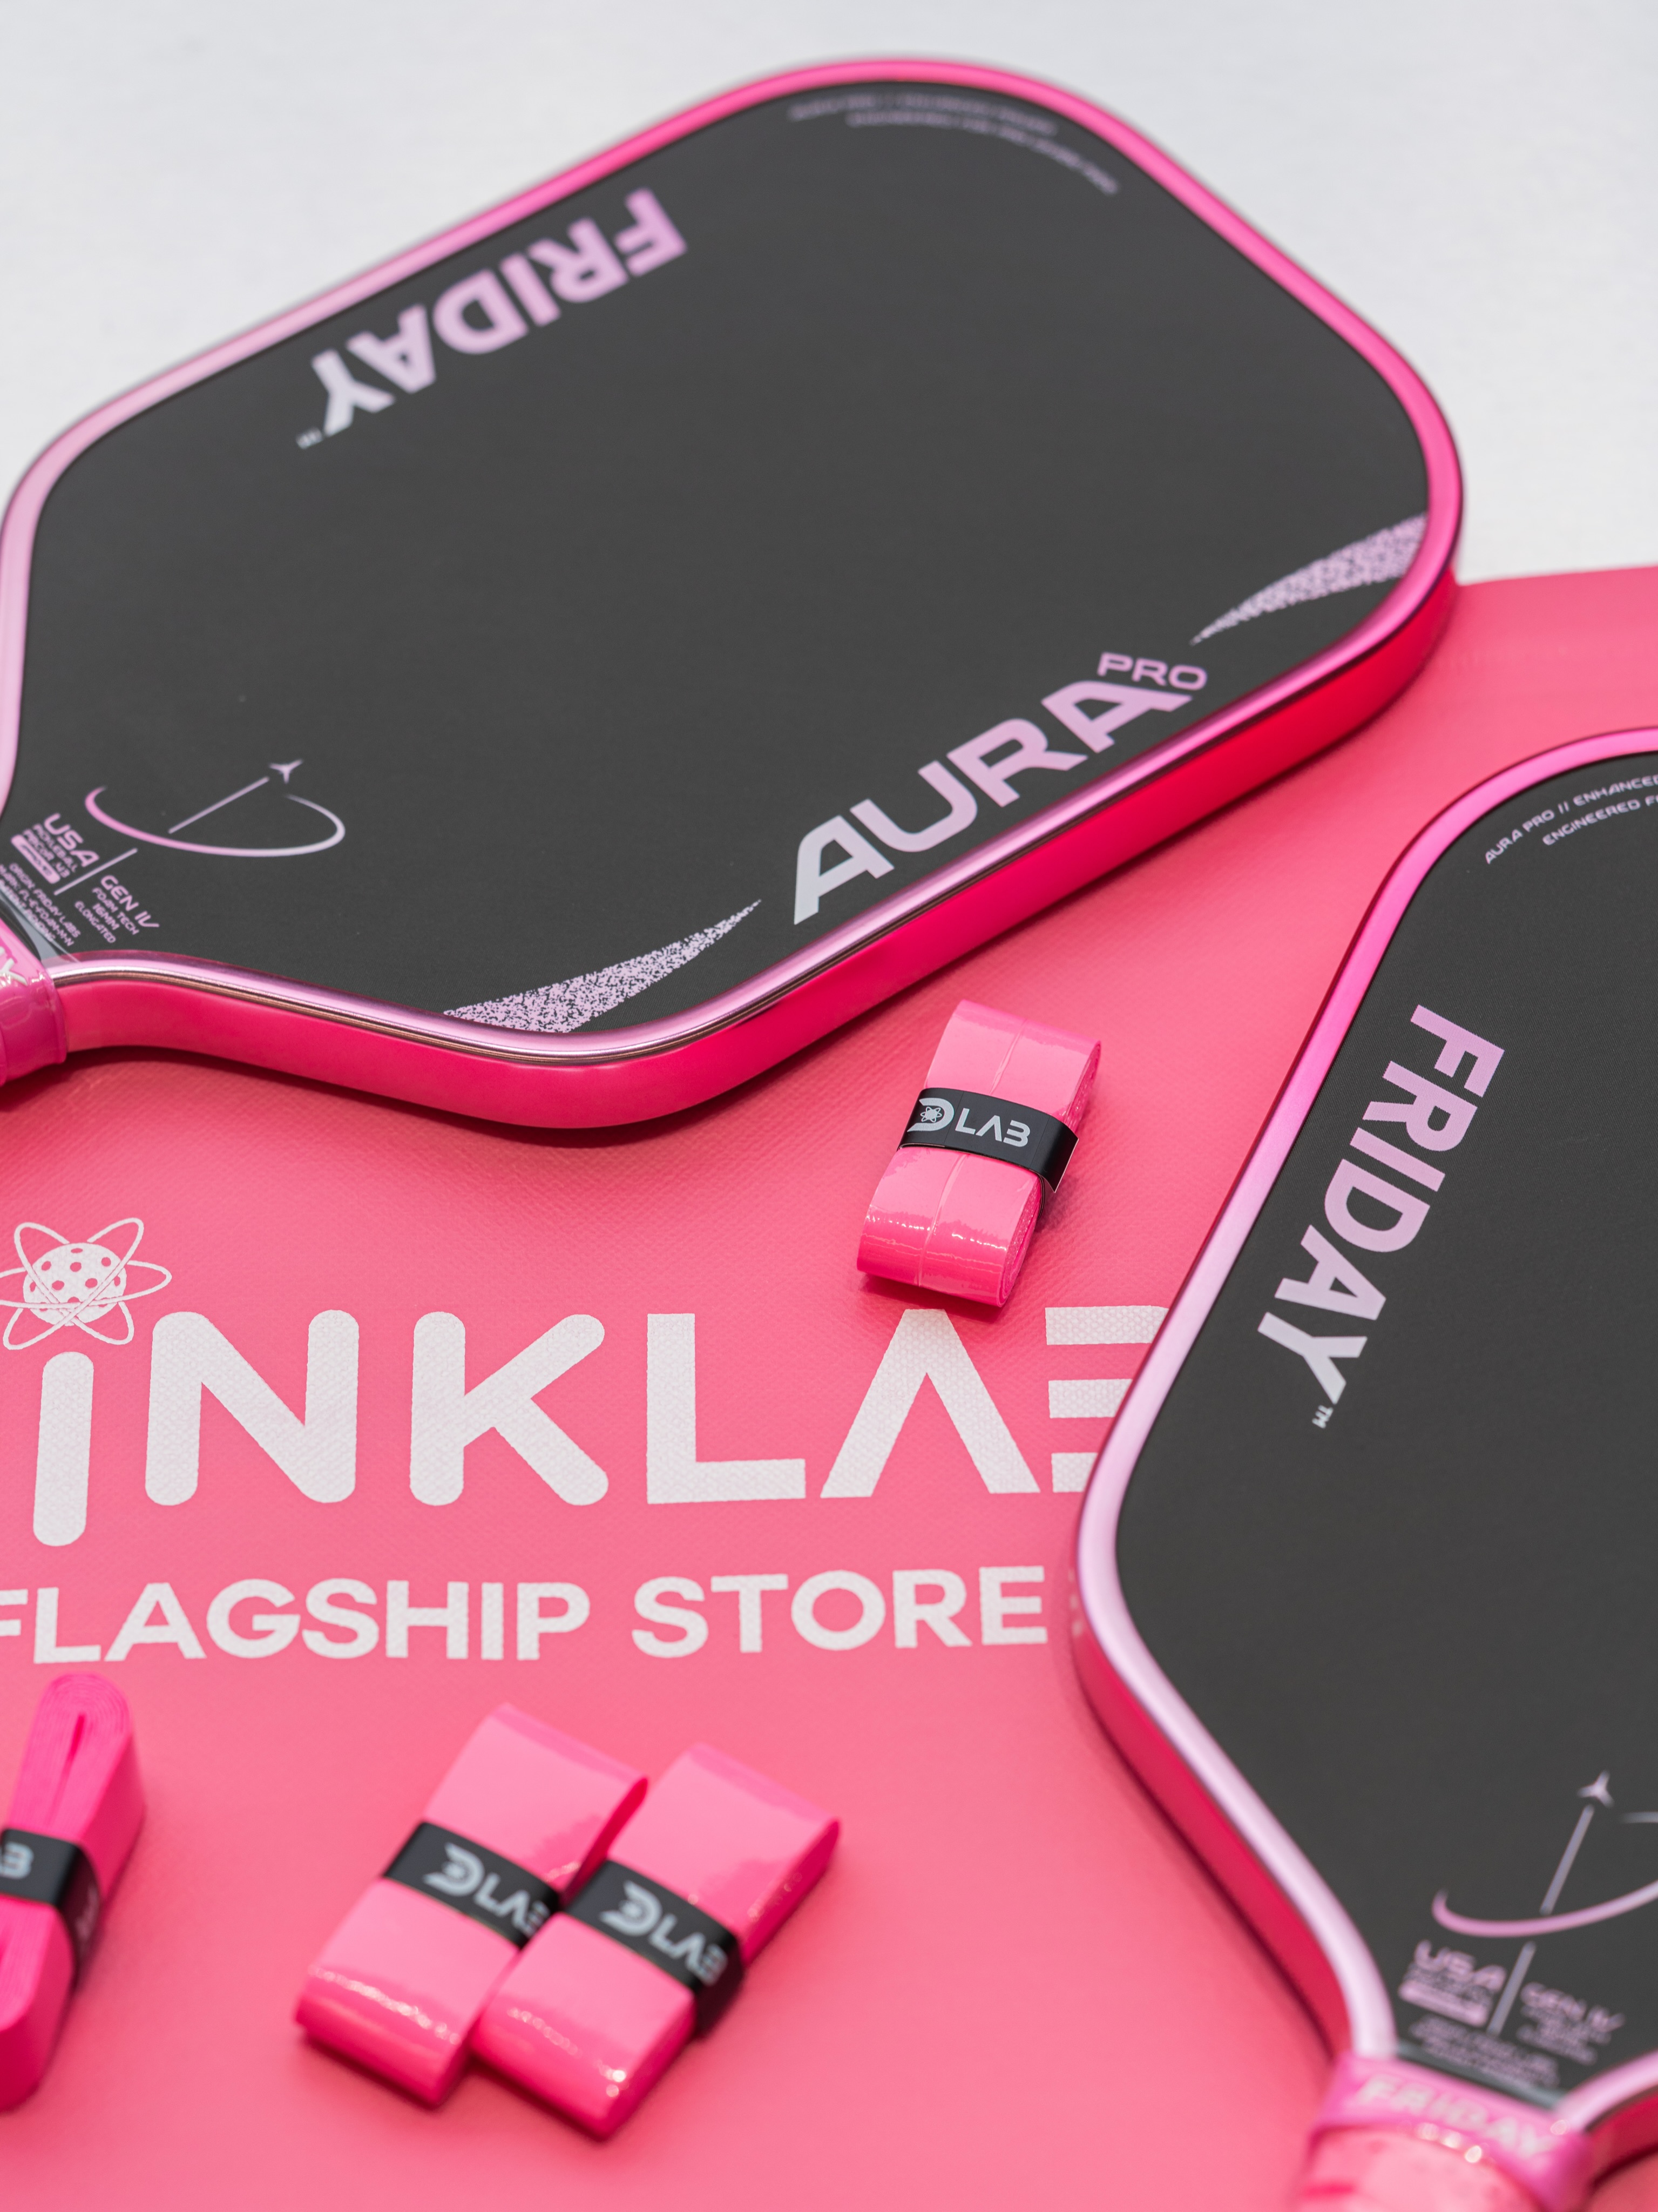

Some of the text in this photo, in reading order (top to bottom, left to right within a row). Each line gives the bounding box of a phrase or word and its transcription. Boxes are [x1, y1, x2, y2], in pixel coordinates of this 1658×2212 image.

[311, 187, 687, 437] FRIDAY
[1097, 652, 1208, 691] PRO
[794, 680, 1192, 926] AURA
[1542, 799, 1641, 846] ENGINEERED
[44, 813, 100, 867] USA
[1485, 829, 1523, 864] AURA
[1522, 809, 1555, 832] PRO
[75, 901, 116, 943] ELONGATED
[92, 887, 139, 935] FOAM TECH
[100, 875, 160, 928] GEN IV
[1256, 1004, 1505, 1405] FRIDAY
[631, 1565, 1048, 1659] STORE
